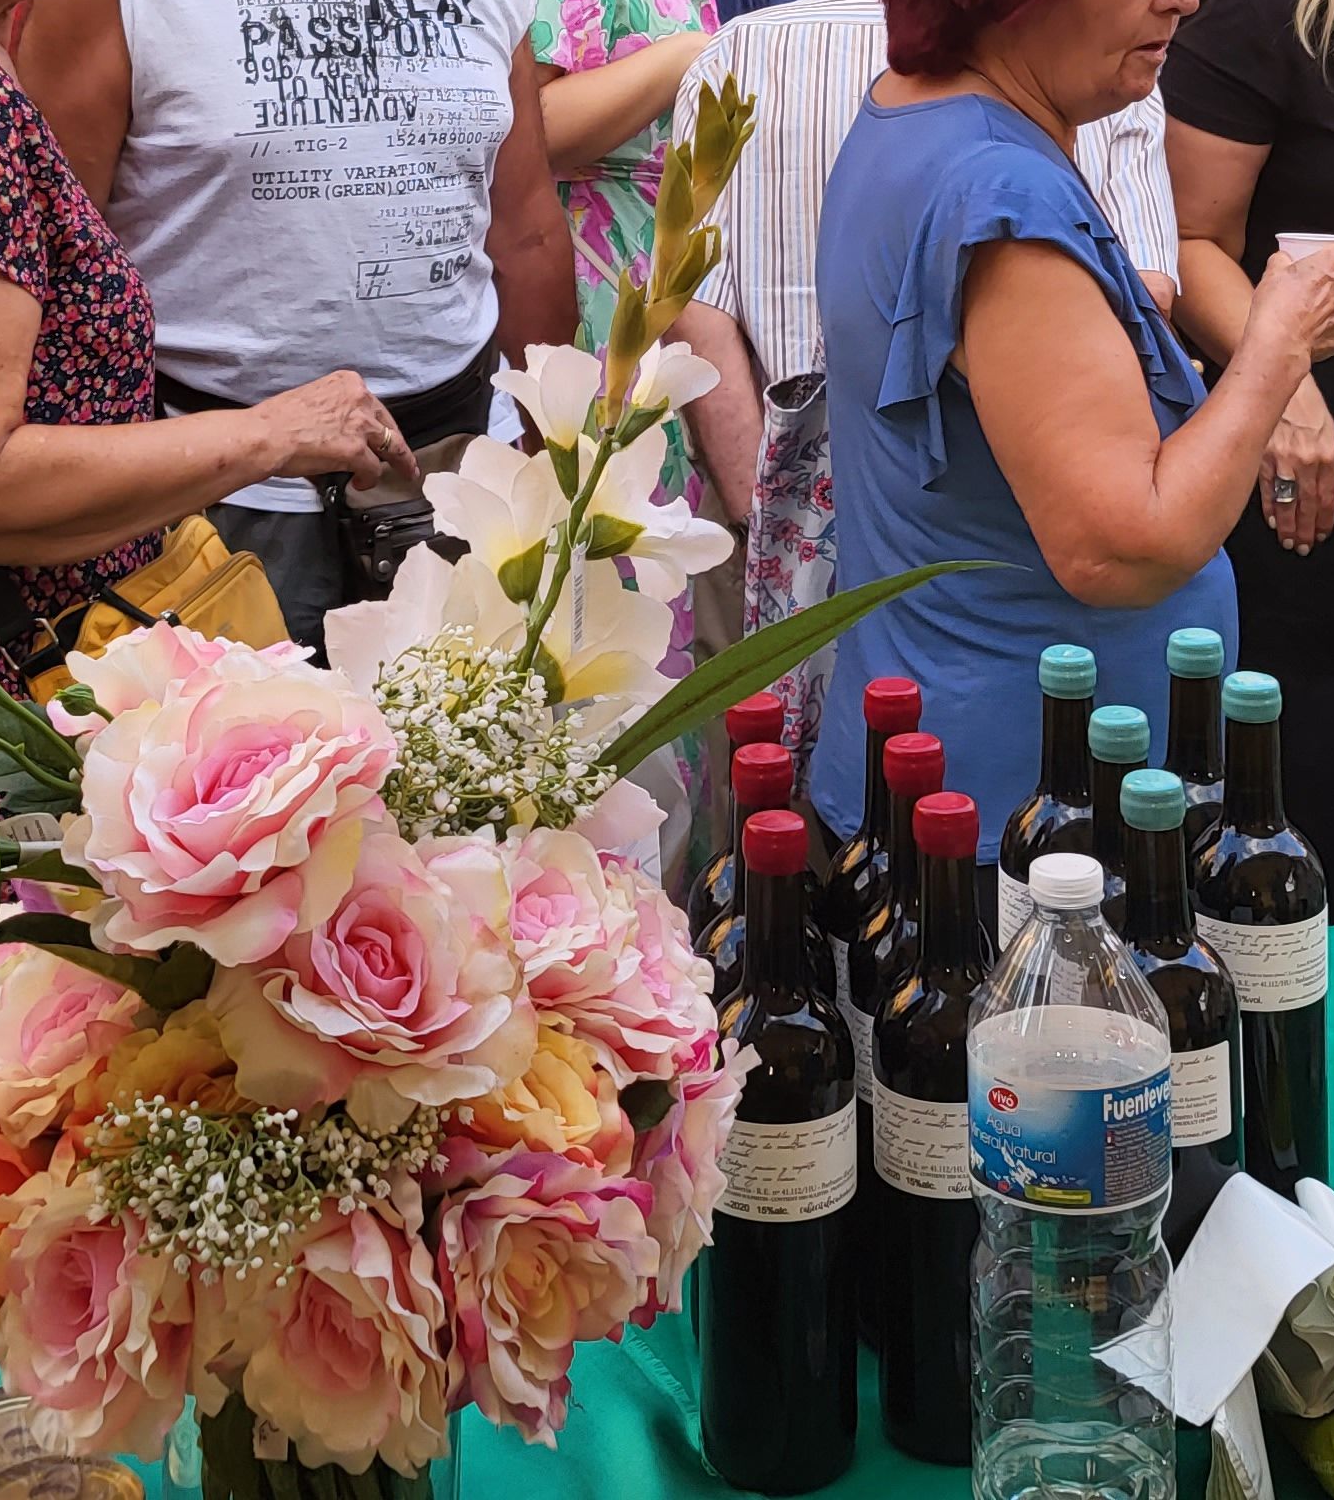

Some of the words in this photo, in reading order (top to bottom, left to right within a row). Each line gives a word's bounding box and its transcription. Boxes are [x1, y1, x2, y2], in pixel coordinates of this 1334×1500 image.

[240, 15, 466, 60] PASSPORT
[252, 168, 333, 186] UTILITY
[344, 161, 438, 181] VARIATION
[986, 1114, 1021, 1137] Agua
[1003, 1140, 1056, 1165] Natural
